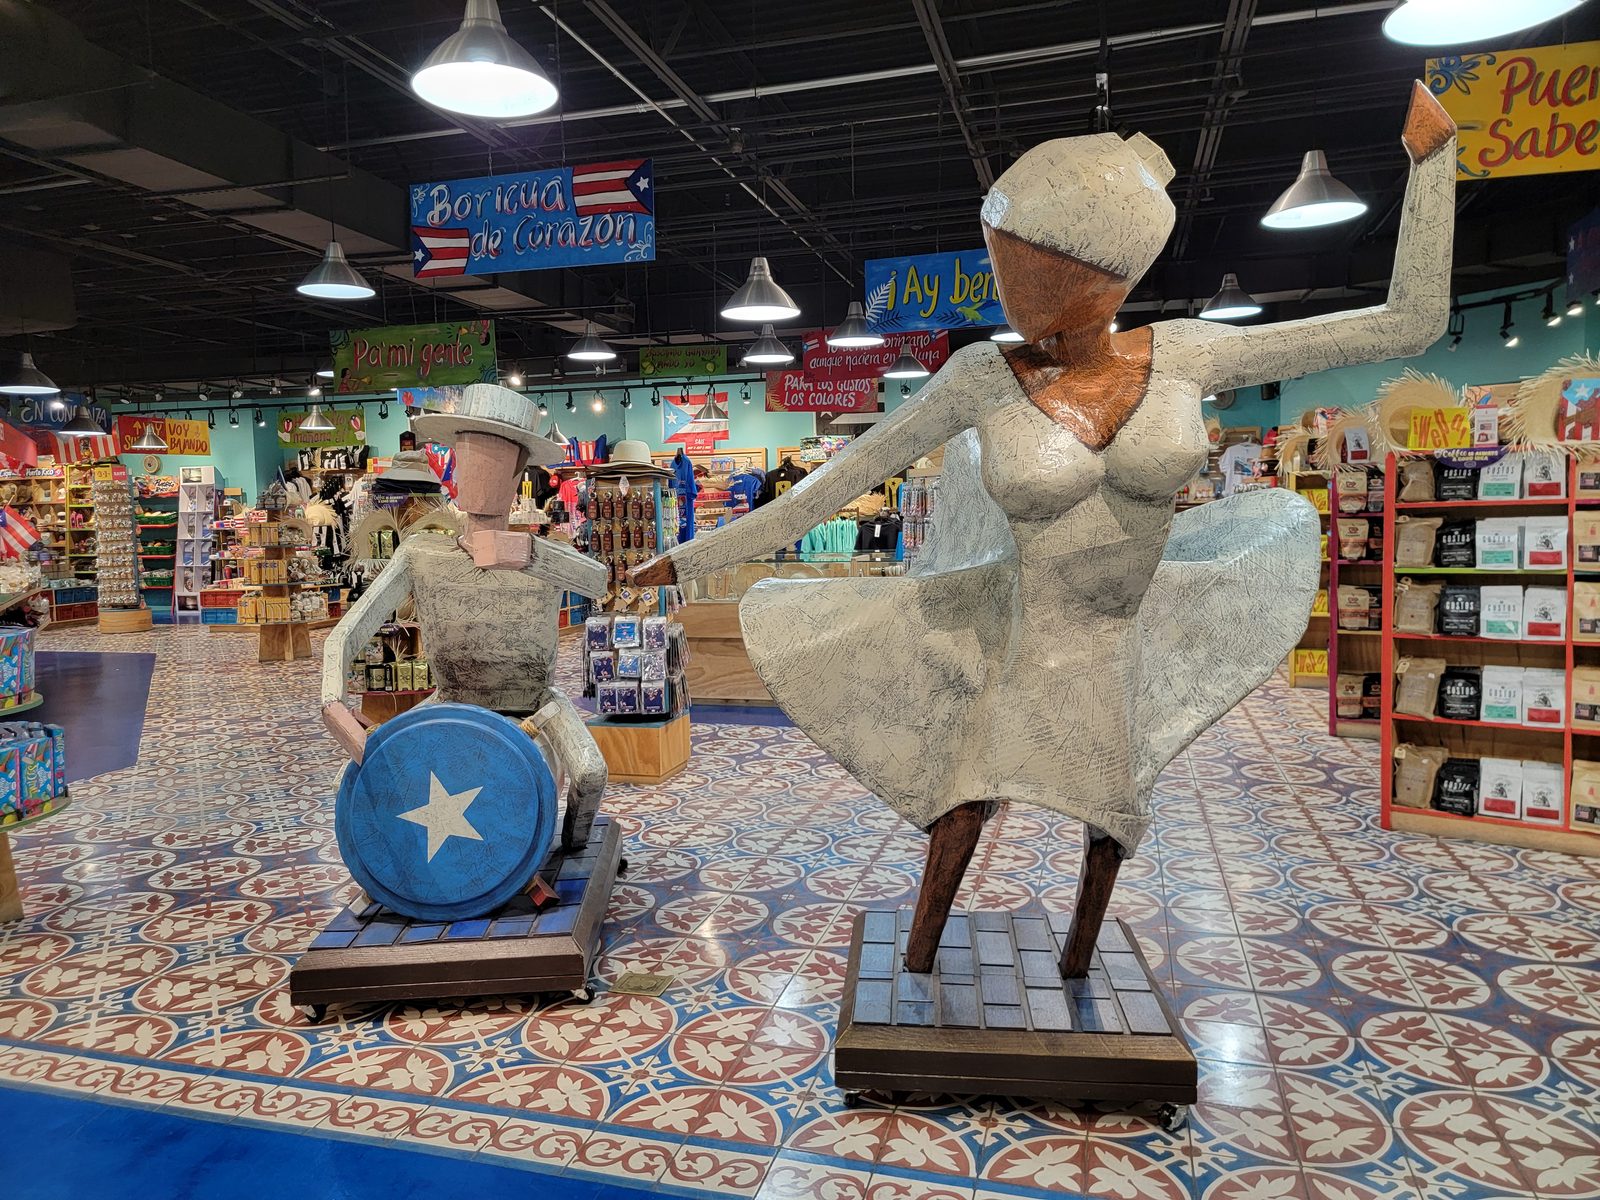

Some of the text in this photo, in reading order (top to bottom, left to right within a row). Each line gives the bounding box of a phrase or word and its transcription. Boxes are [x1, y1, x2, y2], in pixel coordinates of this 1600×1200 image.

[1478, 117, 1600, 168] Sabe
[426, 175, 568, 227] Boricua
[470, 219, 506, 261] de
[419, 333, 474, 378] gente
[809, 356, 843, 375] aunque
[846, 352, 881, 371] naciera
[882, 354, 896, 364] en
[836, 378, 872, 394] GUSTOS
[20, 398, 44, 423] EN
[783, 392, 856, 408] LOS COLORES
[168, 423, 190, 436] VOY
[169, 437, 208, 454] BAJANDO
